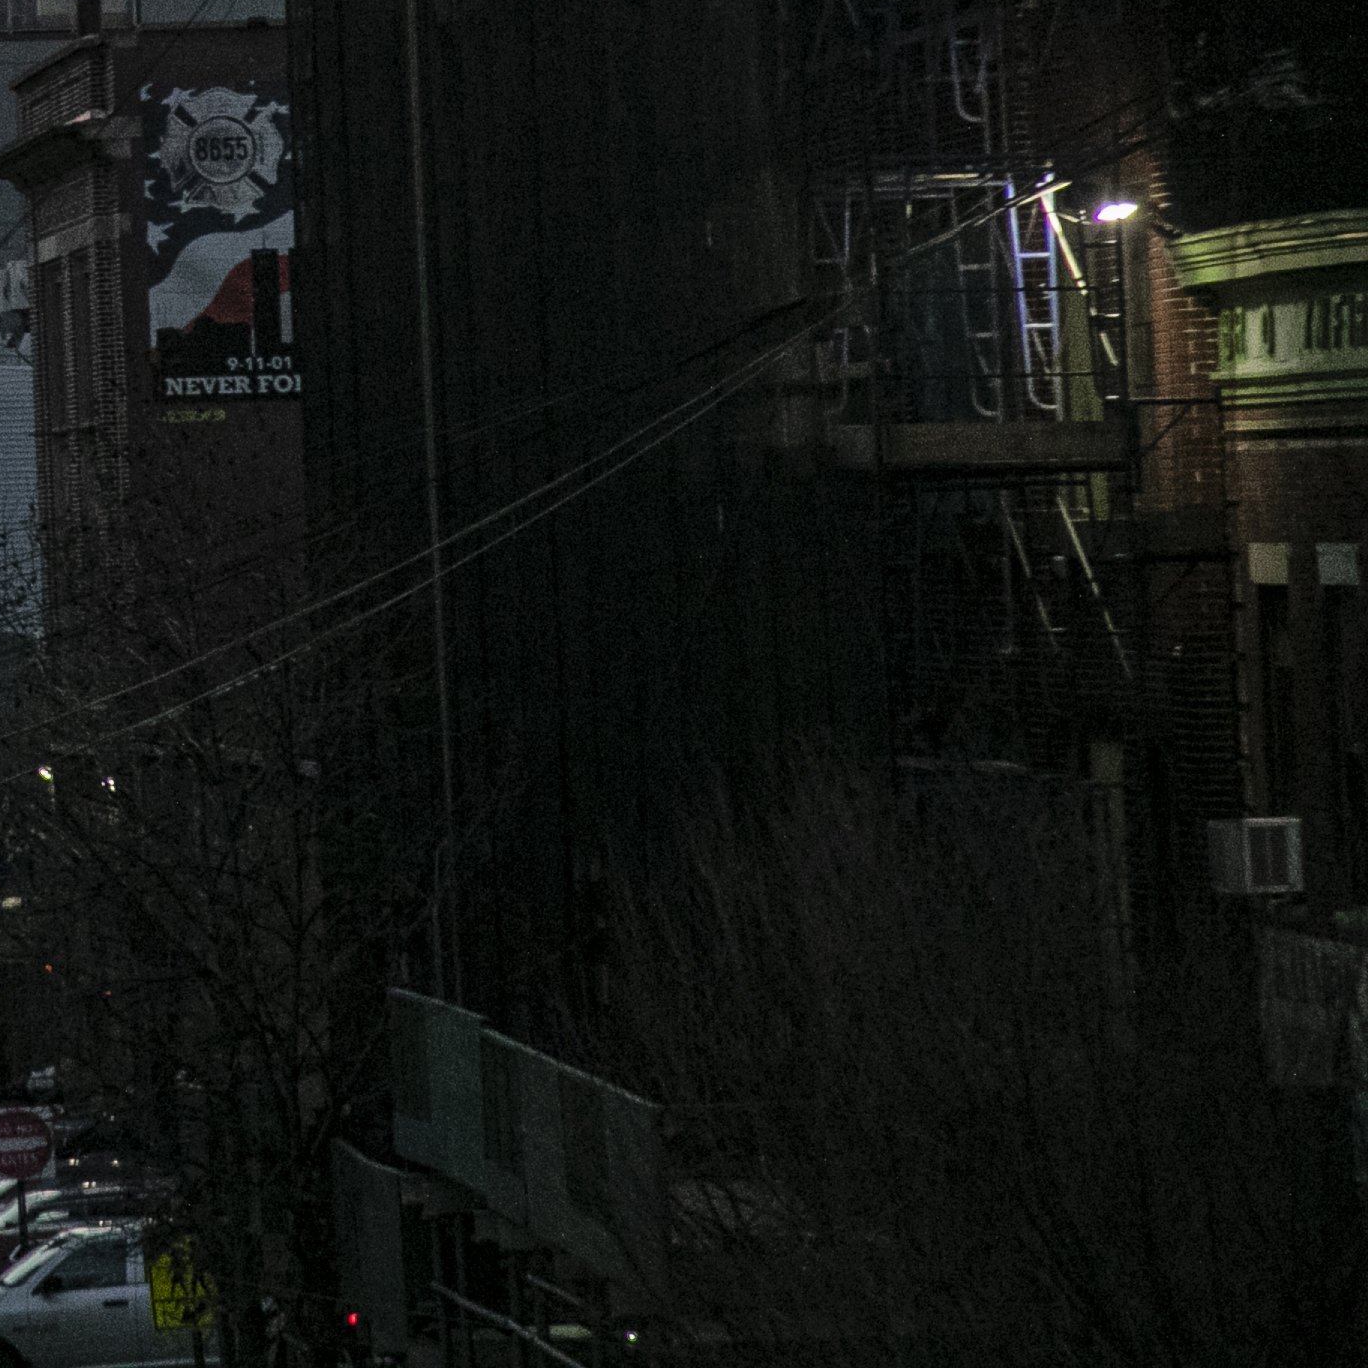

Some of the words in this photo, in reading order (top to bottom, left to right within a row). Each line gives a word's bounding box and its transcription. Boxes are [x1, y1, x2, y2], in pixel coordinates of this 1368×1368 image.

[195, 136, 248, 162] 8655
[227, 355, 292, 371] 9-11-01
[165, 376, 254, 396] NEVER
